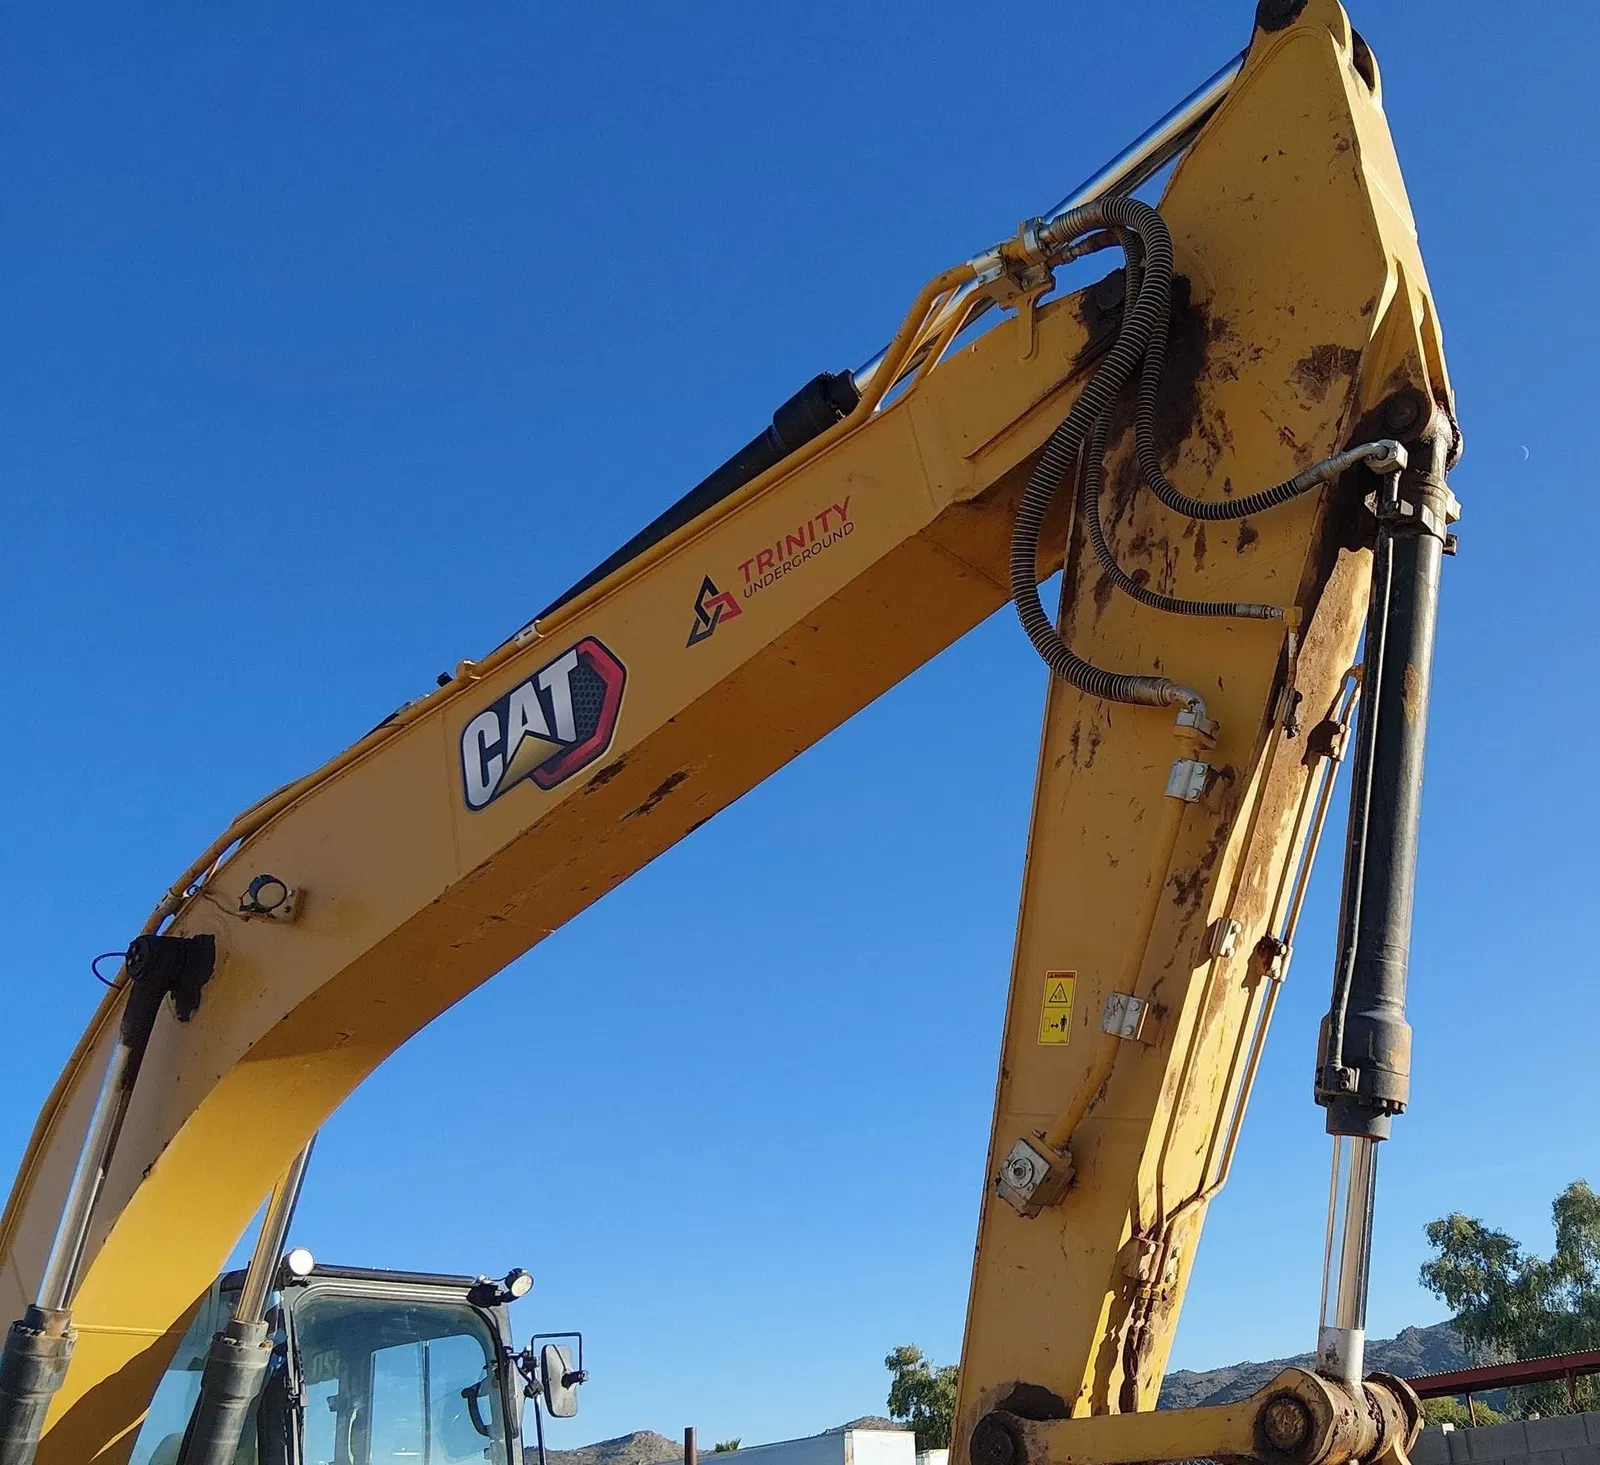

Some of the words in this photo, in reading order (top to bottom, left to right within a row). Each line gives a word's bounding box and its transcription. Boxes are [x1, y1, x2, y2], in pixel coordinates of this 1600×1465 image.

[738, 496, 851, 583] TRINITY
[743, 522, 854, 598] UNDERGROUND
[462, 649, 578, 806] CAT
